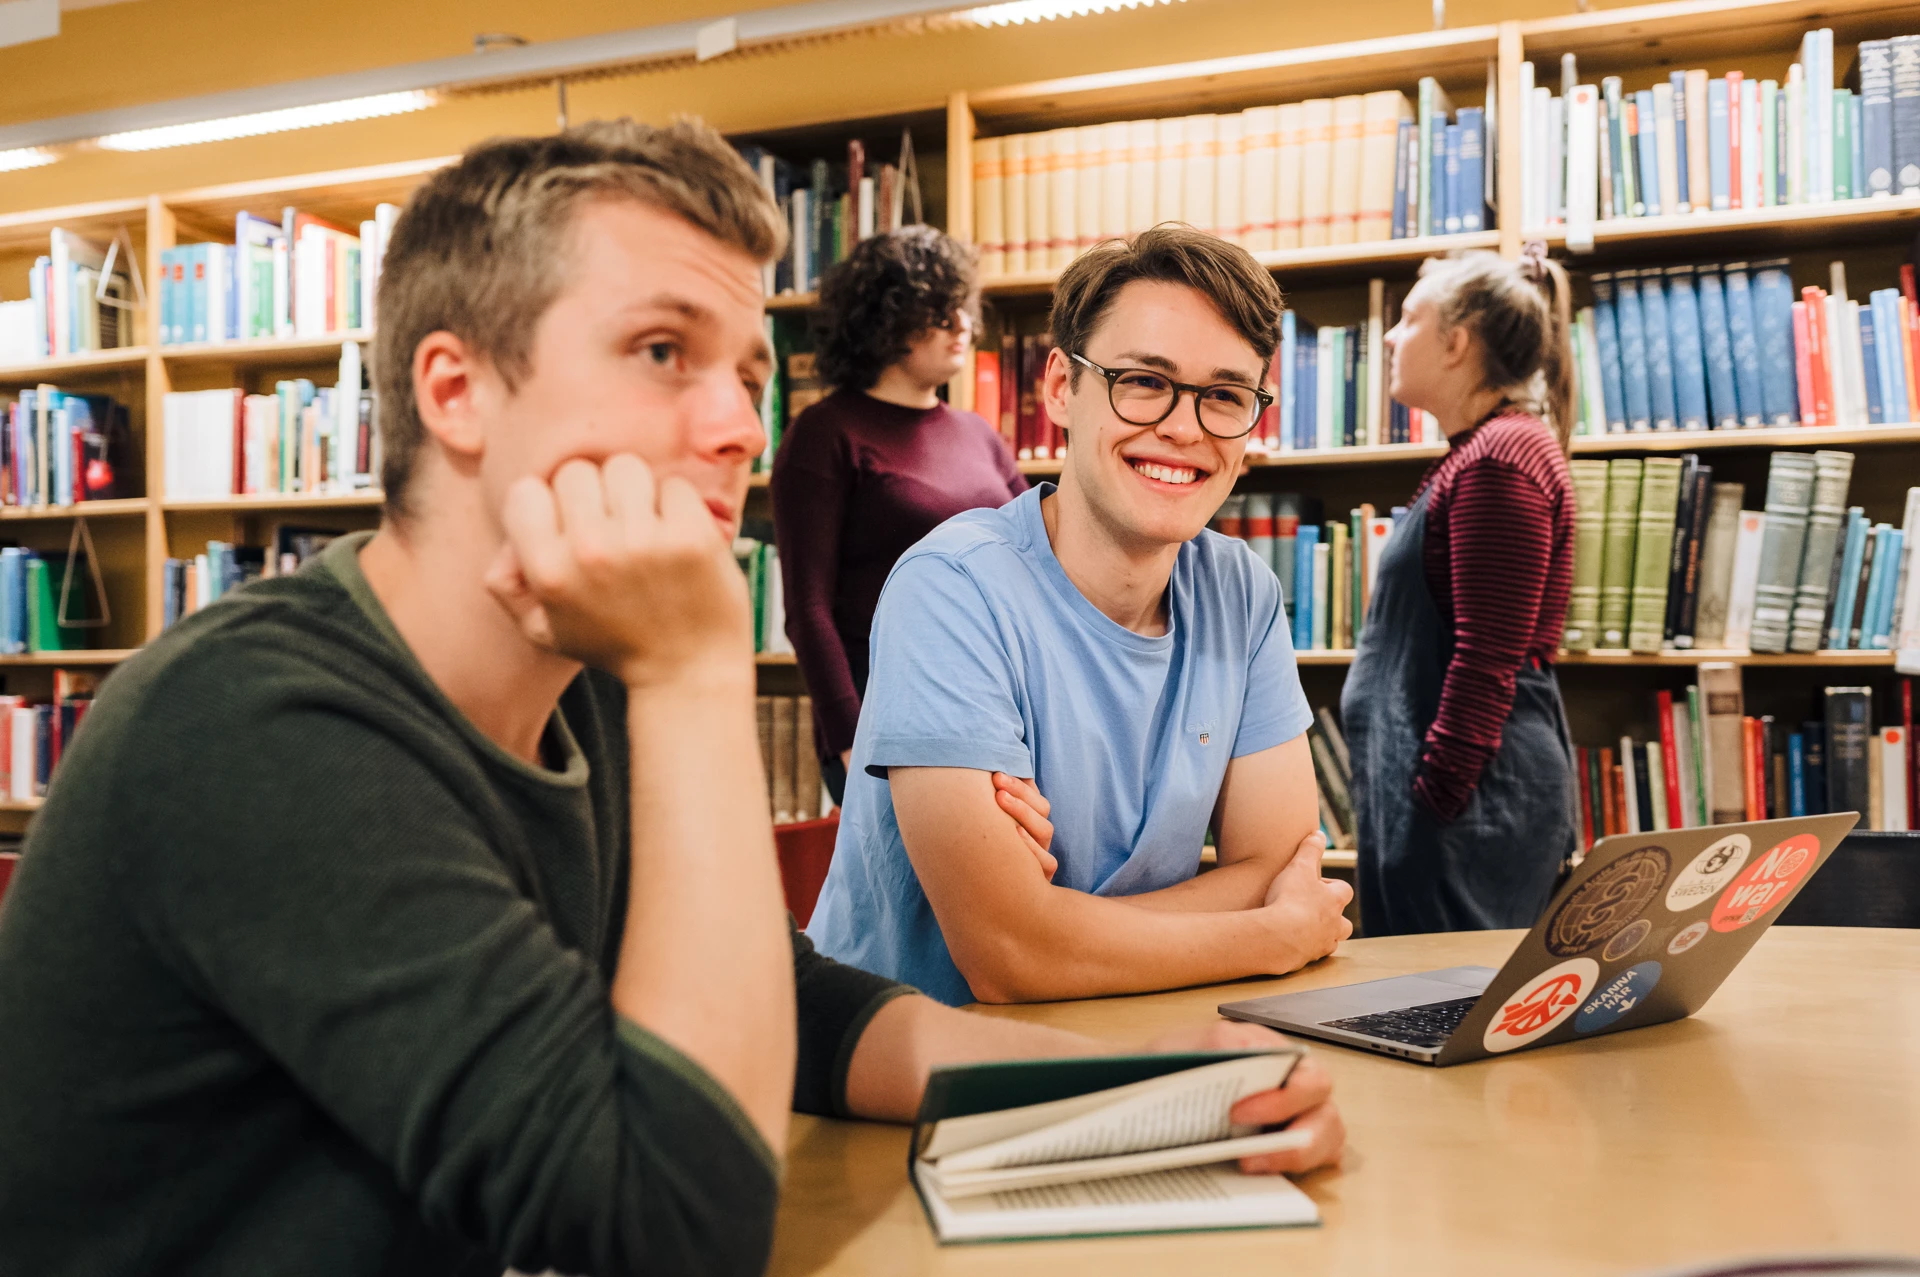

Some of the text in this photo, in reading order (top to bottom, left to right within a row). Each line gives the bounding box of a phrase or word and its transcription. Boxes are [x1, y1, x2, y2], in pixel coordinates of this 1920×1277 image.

[1671, 883, 1718, 898] SWEDEN
[1727, 881, 1789, 908] war
[1583, 970, 1637, 1014] SKANNA
[1604, 986, 1632, 1010] HÄR
